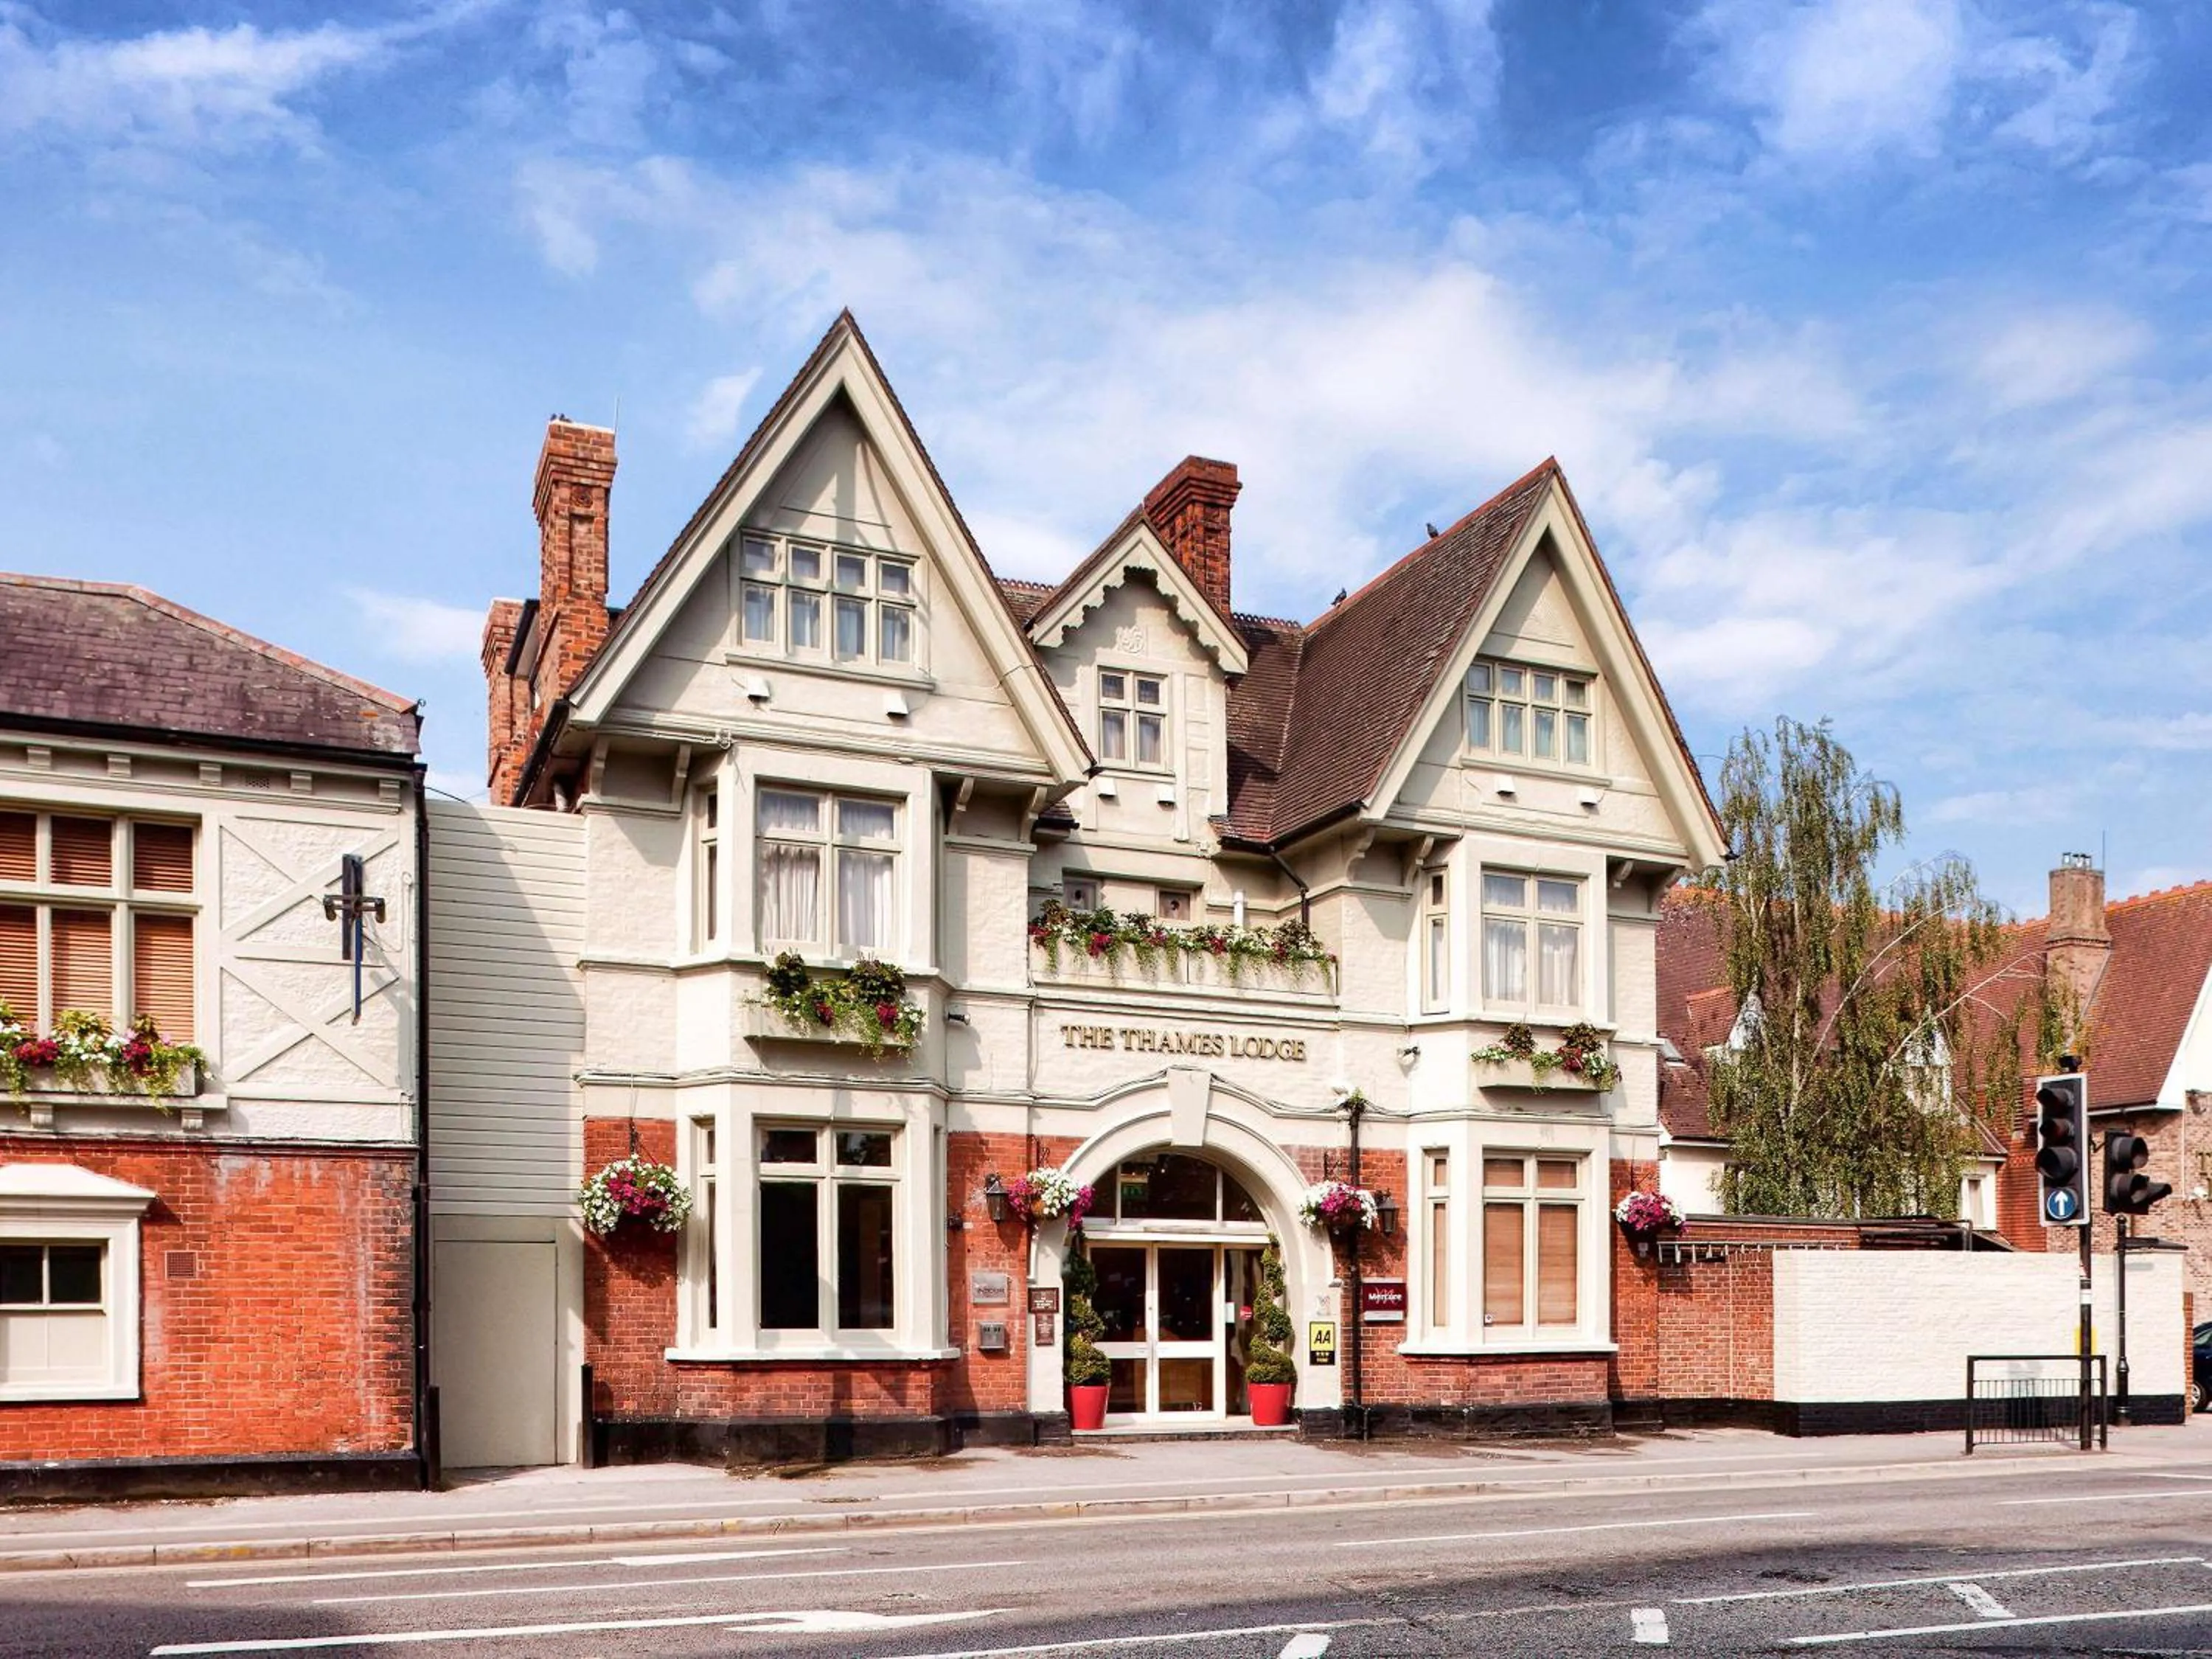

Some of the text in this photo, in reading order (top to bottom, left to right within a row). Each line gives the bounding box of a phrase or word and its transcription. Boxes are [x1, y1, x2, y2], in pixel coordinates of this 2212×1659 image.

[1060, 1025, 1307, 1062] THE THAMES LODGE
[1313, 1329, 1331, 1344] AA
